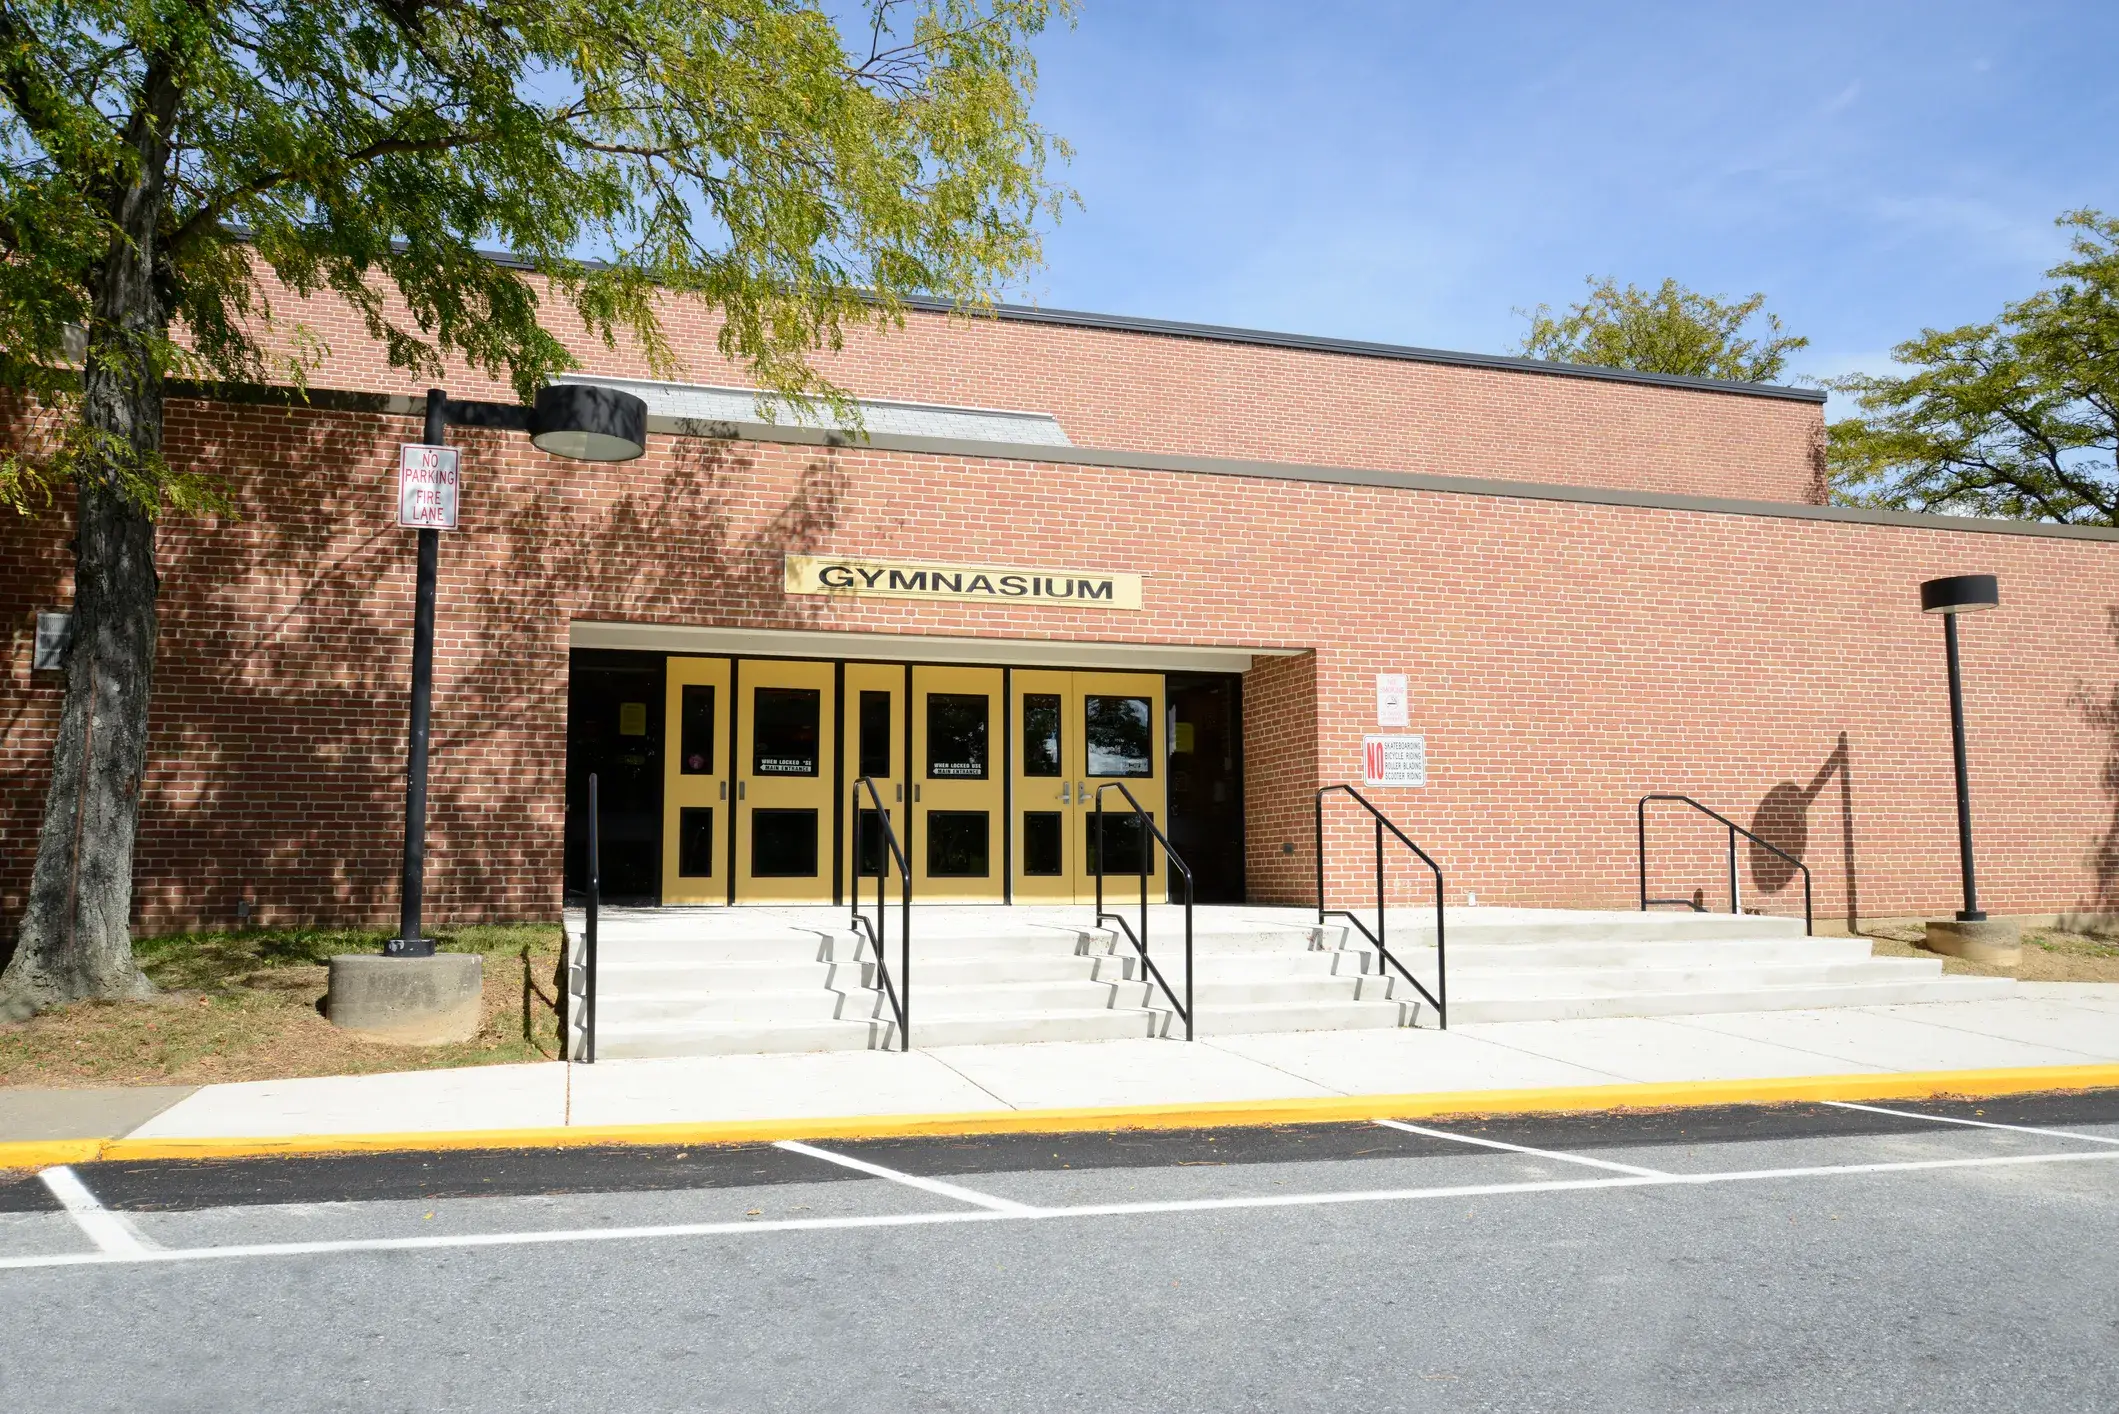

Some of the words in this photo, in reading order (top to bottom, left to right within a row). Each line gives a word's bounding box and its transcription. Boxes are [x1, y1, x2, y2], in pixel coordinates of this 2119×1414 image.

[422, 454, 438, 468] NO
[405, 469, 454, 484] PARKING
[416, 490, 441, 504] FIRE
[413, 506, 444, 521] LANE
[818, 565, 1114, 600] GYMNASIUM
[1384, 741, 1421, 750] SKATEBOARDING
[1367, 742, 1384, 780] NO
[1385, 752, 1404, 760] BICYCLE
[1406, 752, 1421, 760] RIDING
[1385, 762, 1402, 770] ROLLER
[1403, 762, 1421, 770] BLADING
[1385, 772, 1405, 780] SCOOTER
[1406, 772, 1421, 780] RIDING
